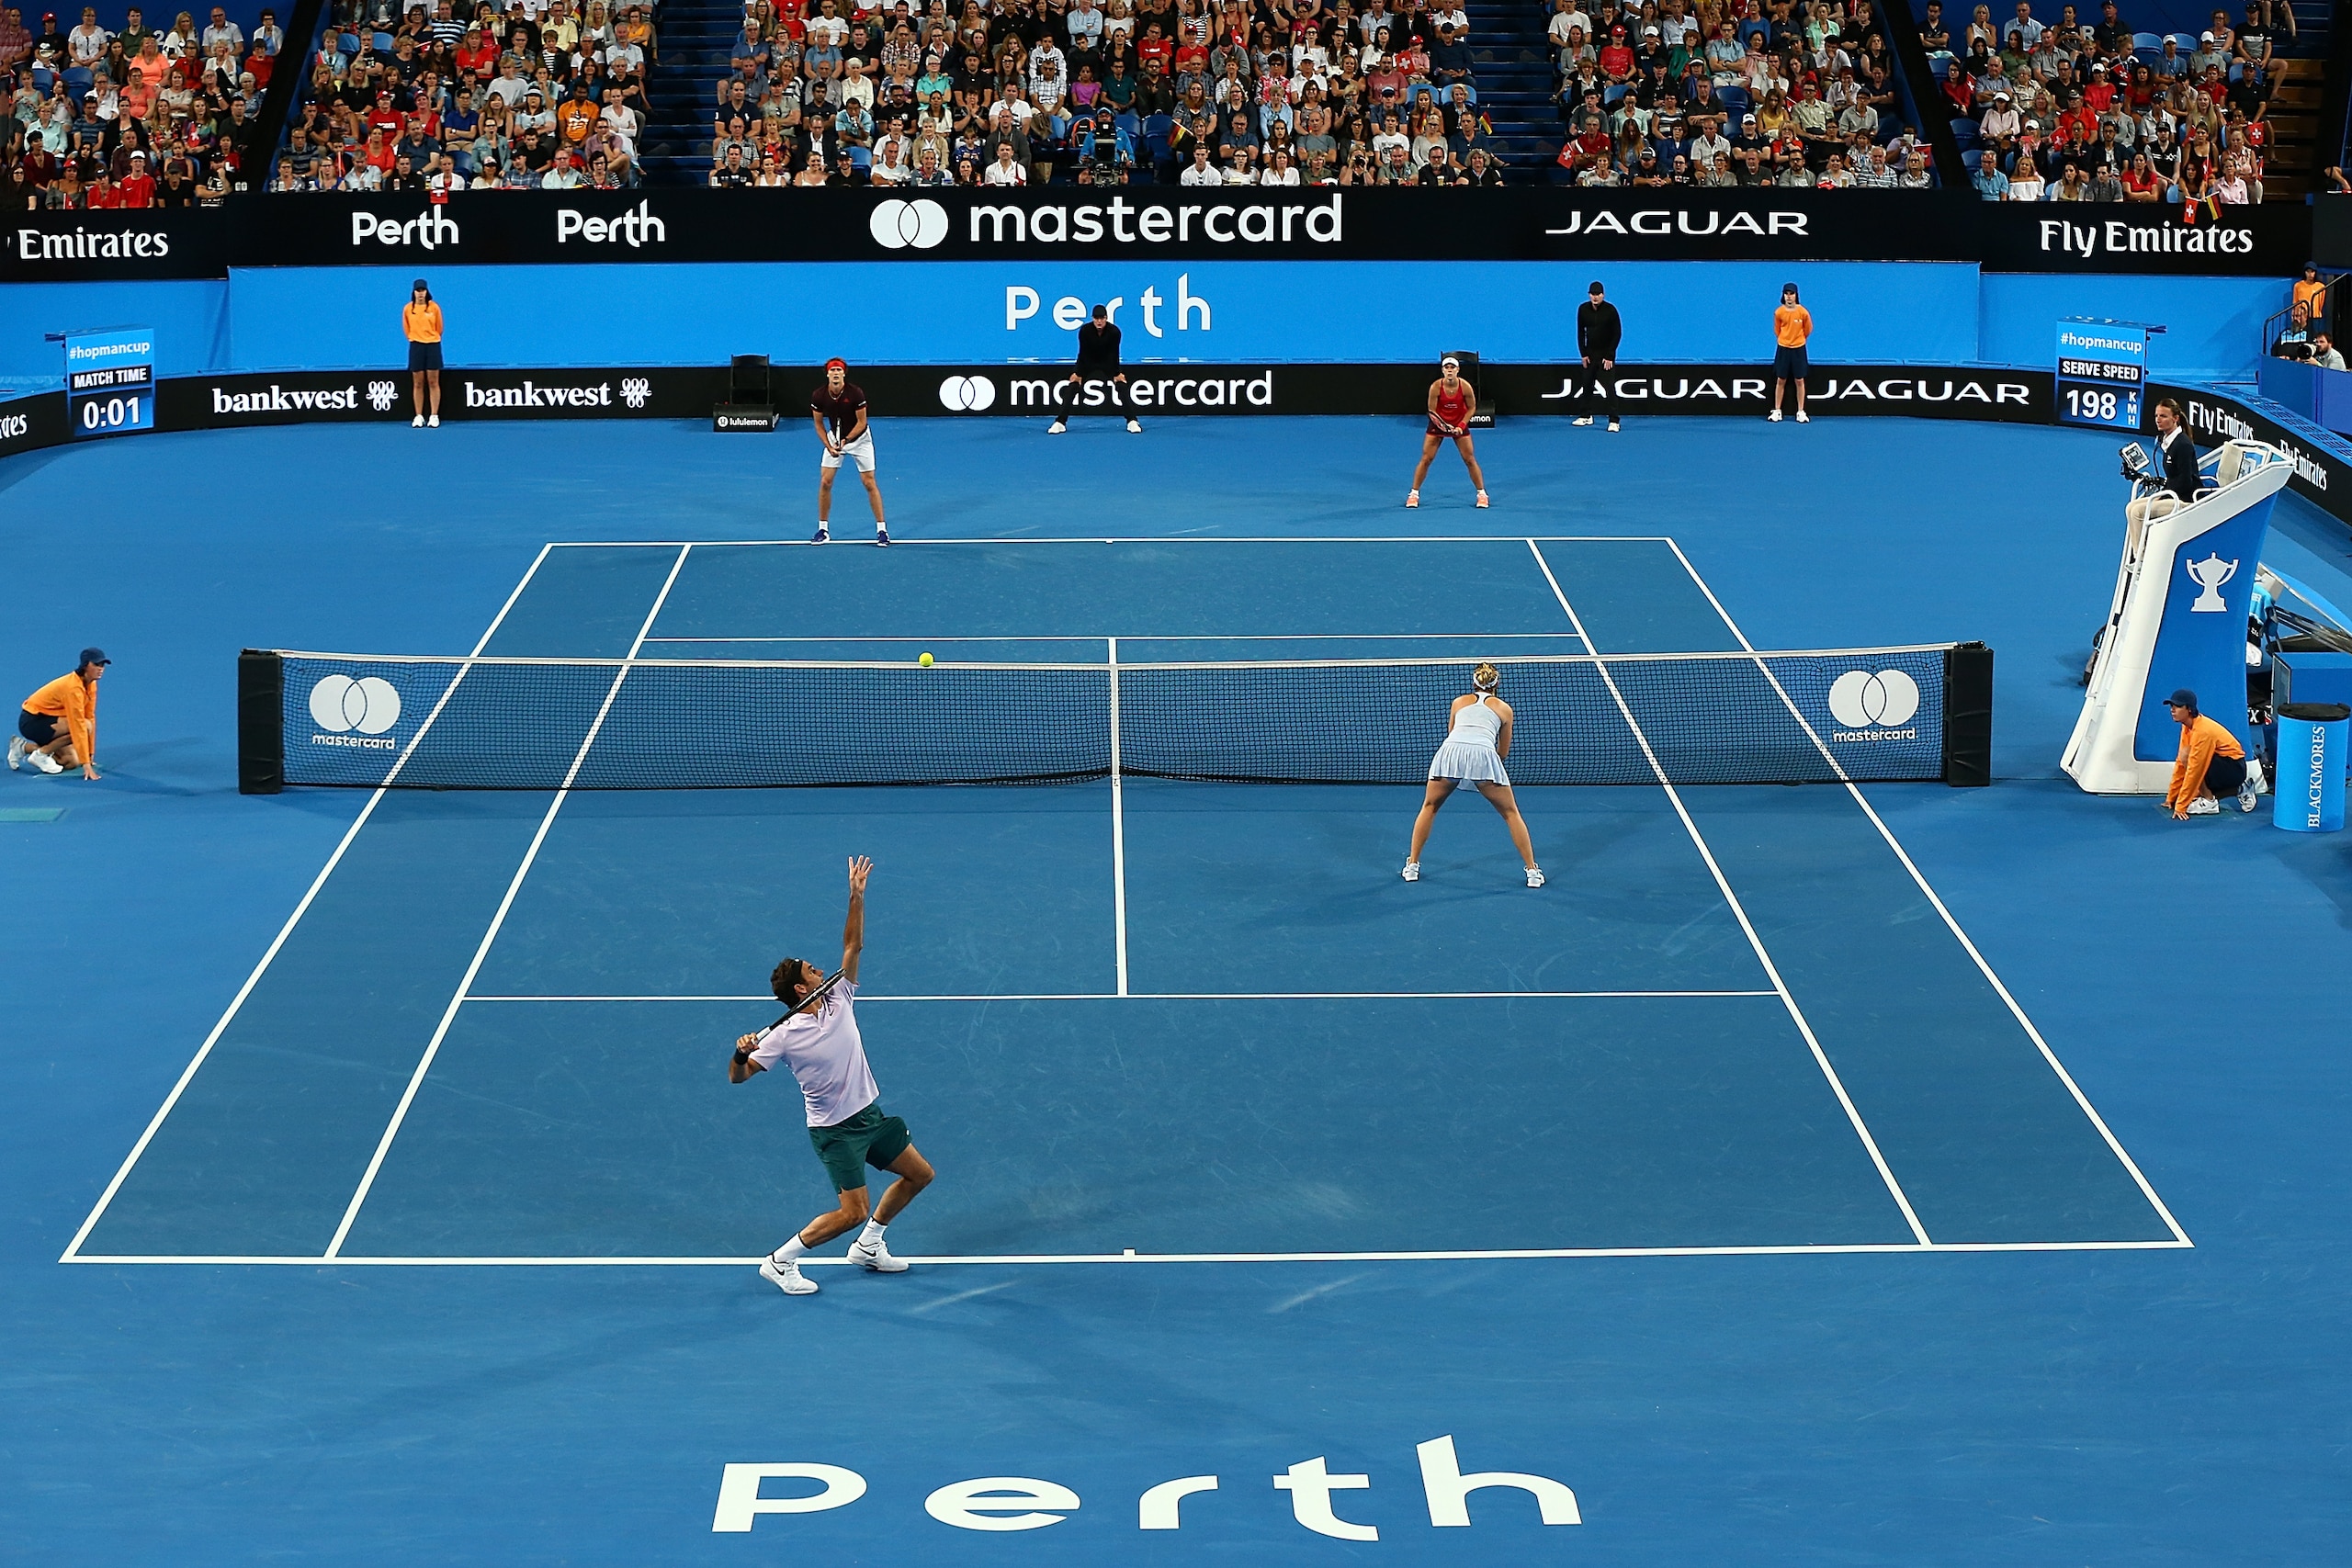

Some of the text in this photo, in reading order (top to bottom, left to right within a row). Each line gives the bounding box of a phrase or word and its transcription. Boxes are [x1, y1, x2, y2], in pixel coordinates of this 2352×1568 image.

[352, 204, 459, 250] Perth
[557, 198, 665, 248] Perth
[970, 193, 1342, 243] mastercard
[1545, 210, 1809, 236] JAGUAR
[17, 226, 169, 260] Emirates
[2040, 220, 2254, 258] Fly Emirates
[1006, 272, 1211, 338] Perth
[69, 342, 151, 359] #hopmancup
[2061, 333, 2143, 355] #hopmancup
[74, 367, 147, 389] MATCH TIME
[2062, 360, 2139, 380] SERVE SPEED
[211, 385, 359, 413] bankwest
[464, 380, 612, 408] bankwest
[1806, 378, 2030, 405] JAGUAR
[2066, 389, 2117, 421] 198
[83, 396, 140, 430] 0:01
[729, 417, 769, 427] lululemon
[2188, 400, 2255, 441] Fly Emirates
[311, 735, 396, 750] mastercard
[1832, 727, 1916, 743] mastercard
[2307, 724, 2325, 829] BLACKMORES
[711, 1434, 1583, 1542] Perth
